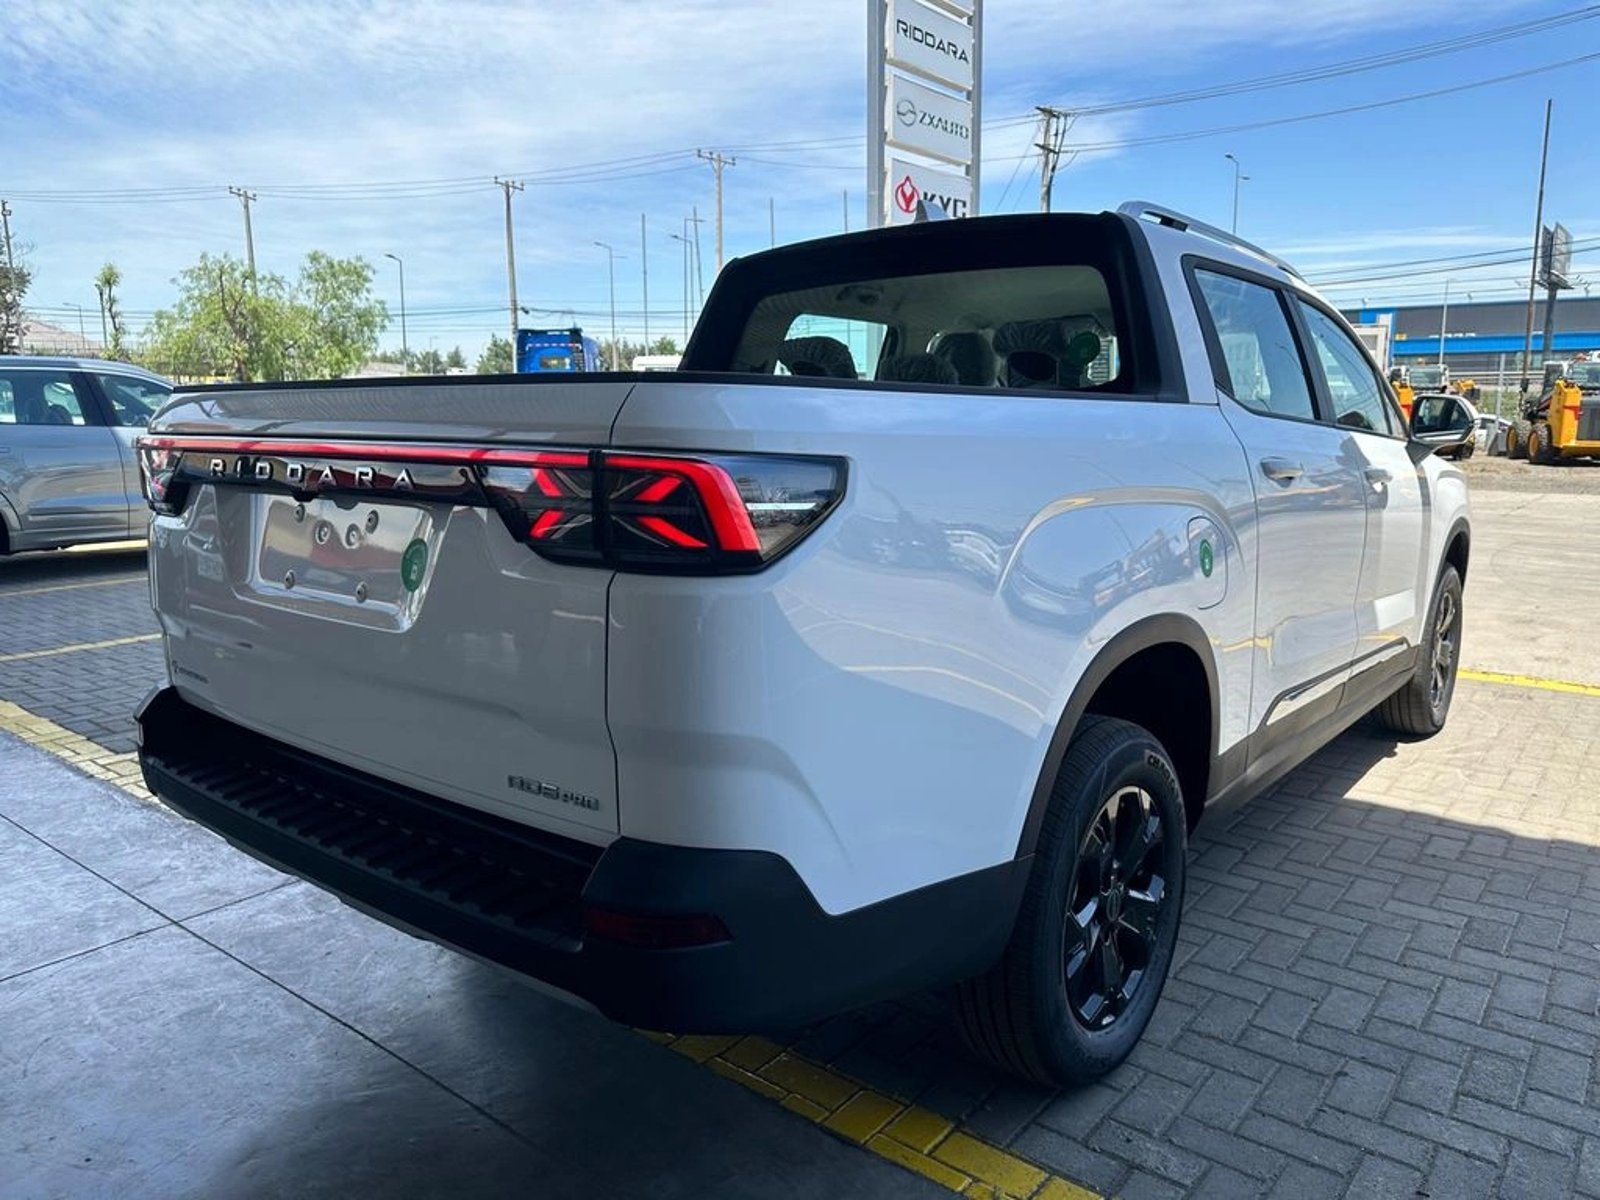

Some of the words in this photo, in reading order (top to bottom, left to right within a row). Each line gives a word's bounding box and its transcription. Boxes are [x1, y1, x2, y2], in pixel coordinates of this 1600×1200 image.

[897, 19, 969, 64] RIDDARA
[919, 109, 969, 139] ZXAUTO
[209, 458, 415, 490] RIDDARA
